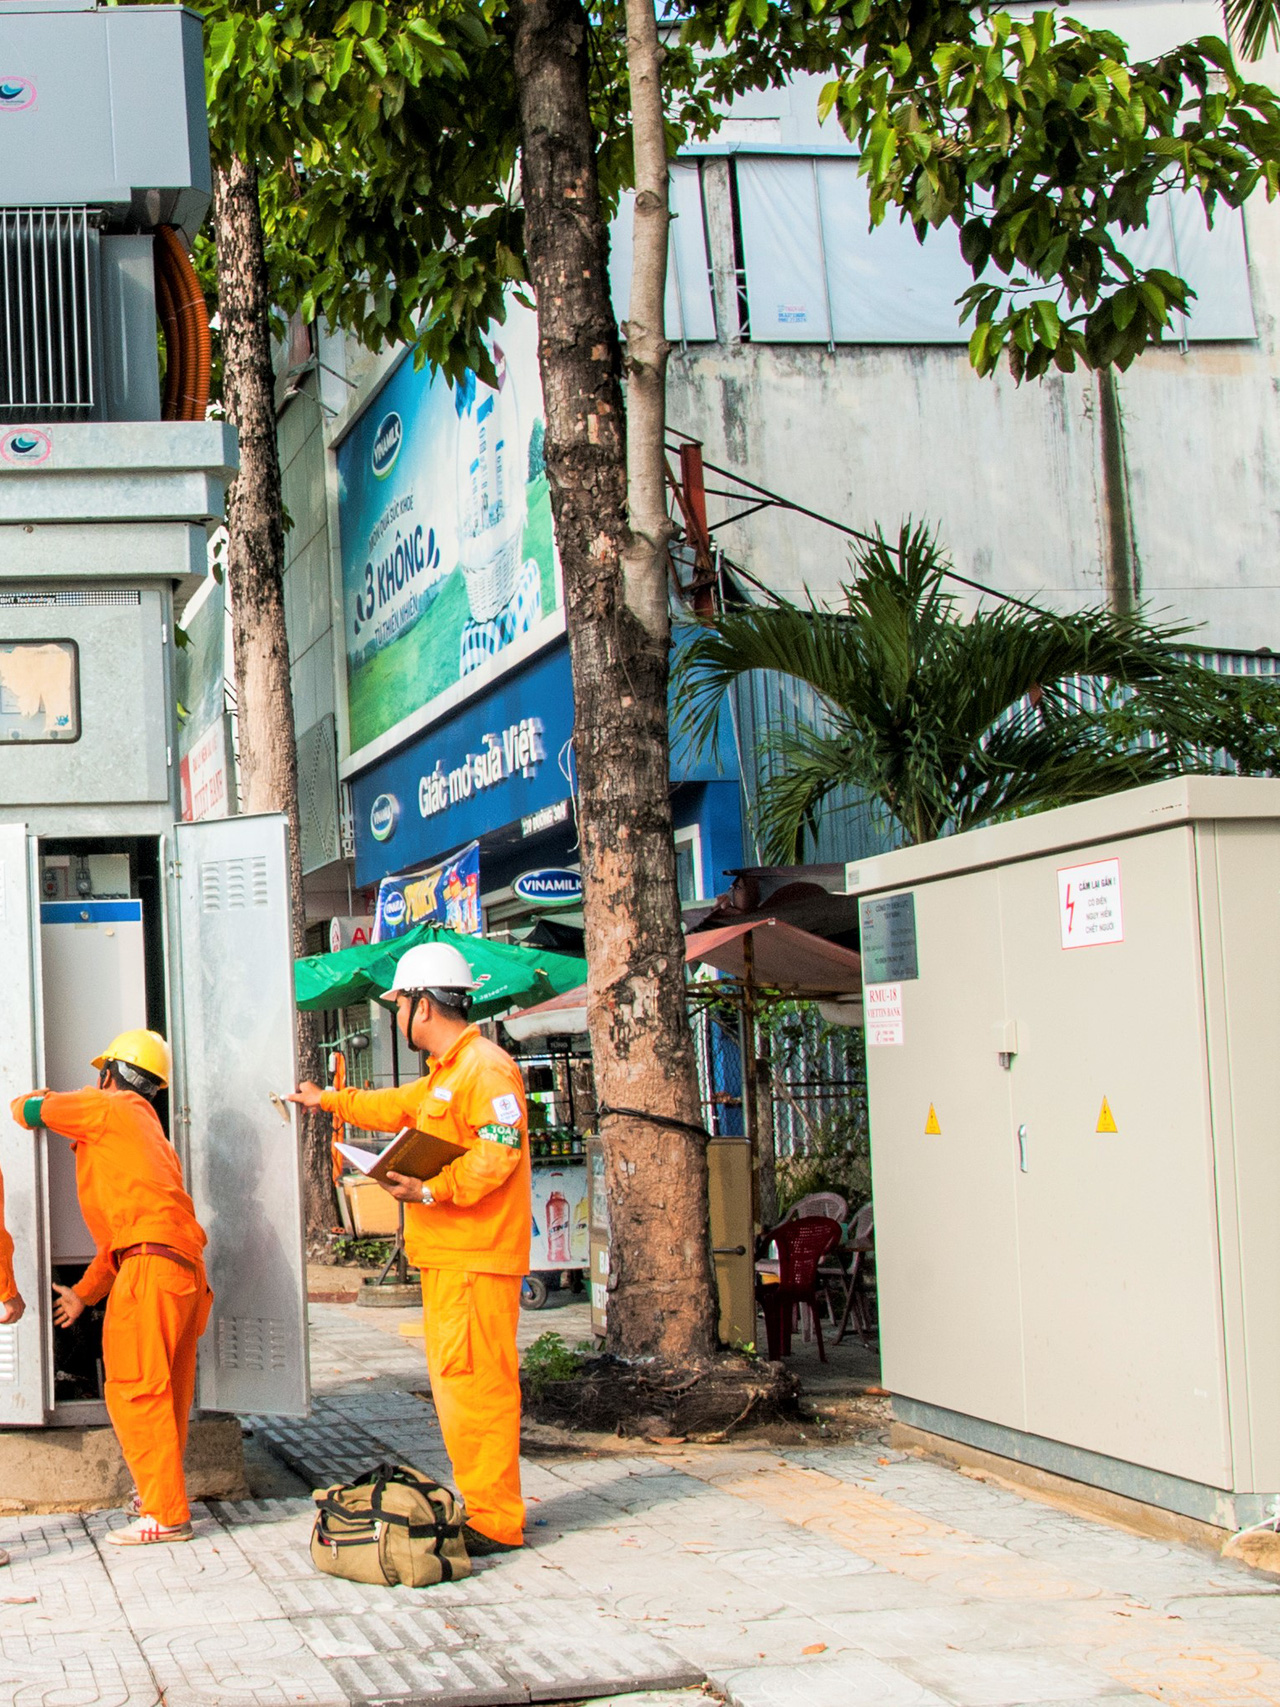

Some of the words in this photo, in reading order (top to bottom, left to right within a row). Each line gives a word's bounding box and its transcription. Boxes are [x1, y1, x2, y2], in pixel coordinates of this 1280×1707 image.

[375, 421, 400, 464] VINAMILK
[365, 562, 375, 620] 3
[376, 525, 424, 608] KHÔNG
[16, 596, 55, 605] Technology
[418, 759, 447, 818] Giấc
[449, 754, 471, 803] mơ
[474, 733, 503, 790] sữa
[502, 717, 539, 779] Việt
[522, 880, 582, 891] VINAMILK
[870, 987, 897, 1003] RMU-18
